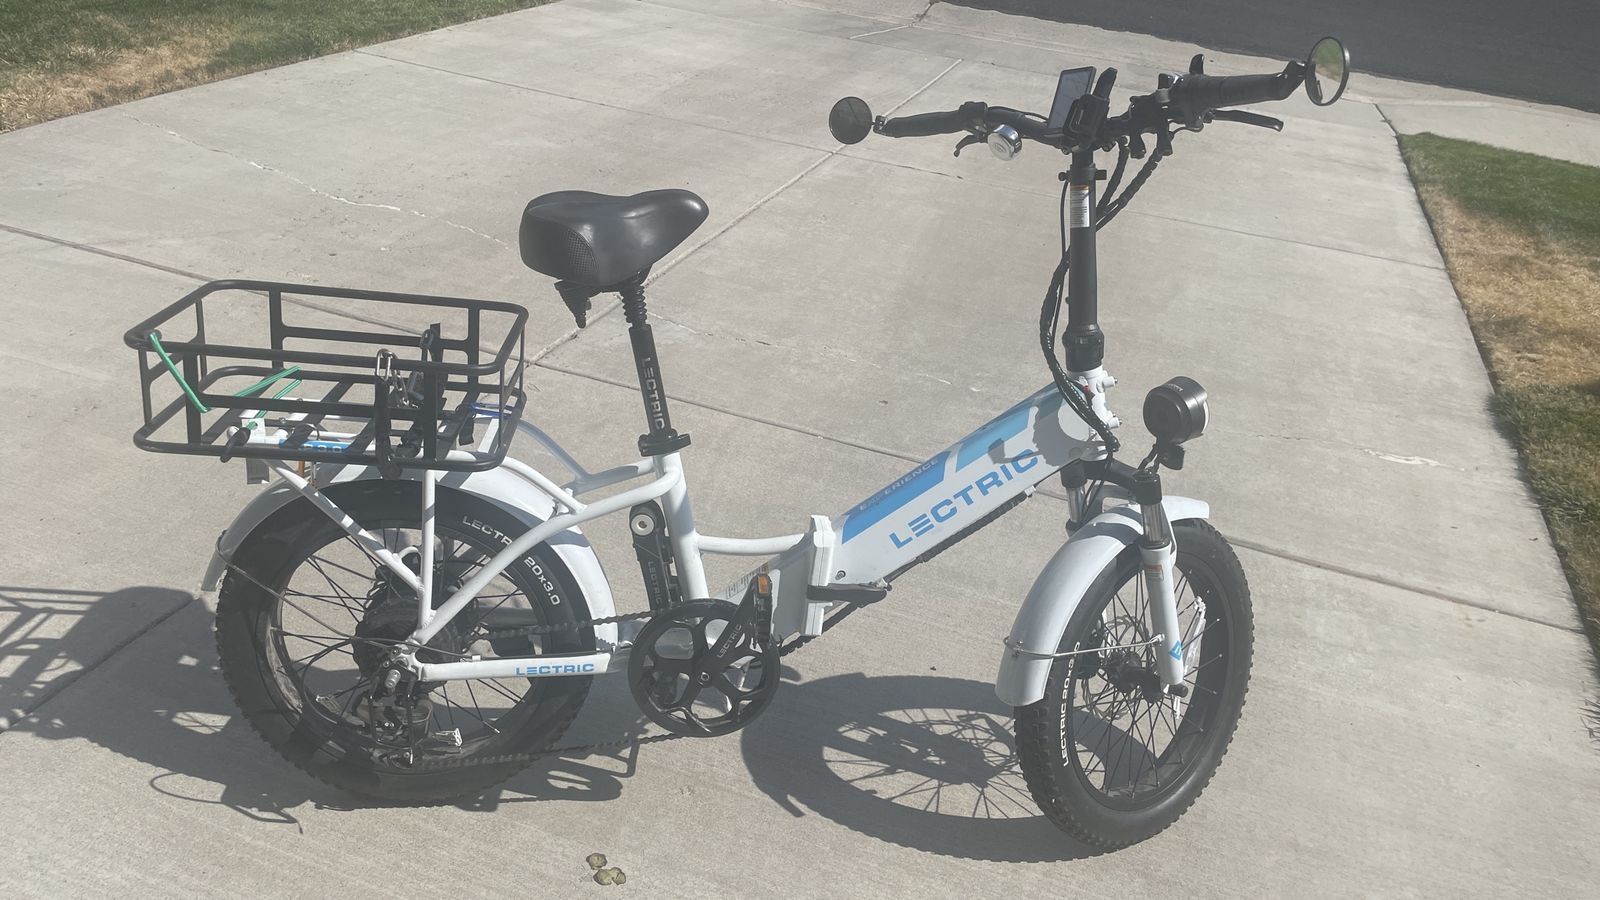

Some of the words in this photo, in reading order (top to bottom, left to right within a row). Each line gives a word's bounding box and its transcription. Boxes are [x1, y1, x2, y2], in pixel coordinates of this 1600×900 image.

[641, 357, 665, 430] LECTRIC
[889, 448, 1038, 549] LECTRIC
[462, 516, 513, 546] LECTR
[523, 556, 561, 605] 20x3.0
[647, 560, 663, 605] LECTRIC
[516, 663, 595, 676] LECTRIC
[716, 624, 742, 659] LECTRIC
[1060, 702, 1069, 767] LECTRIC
